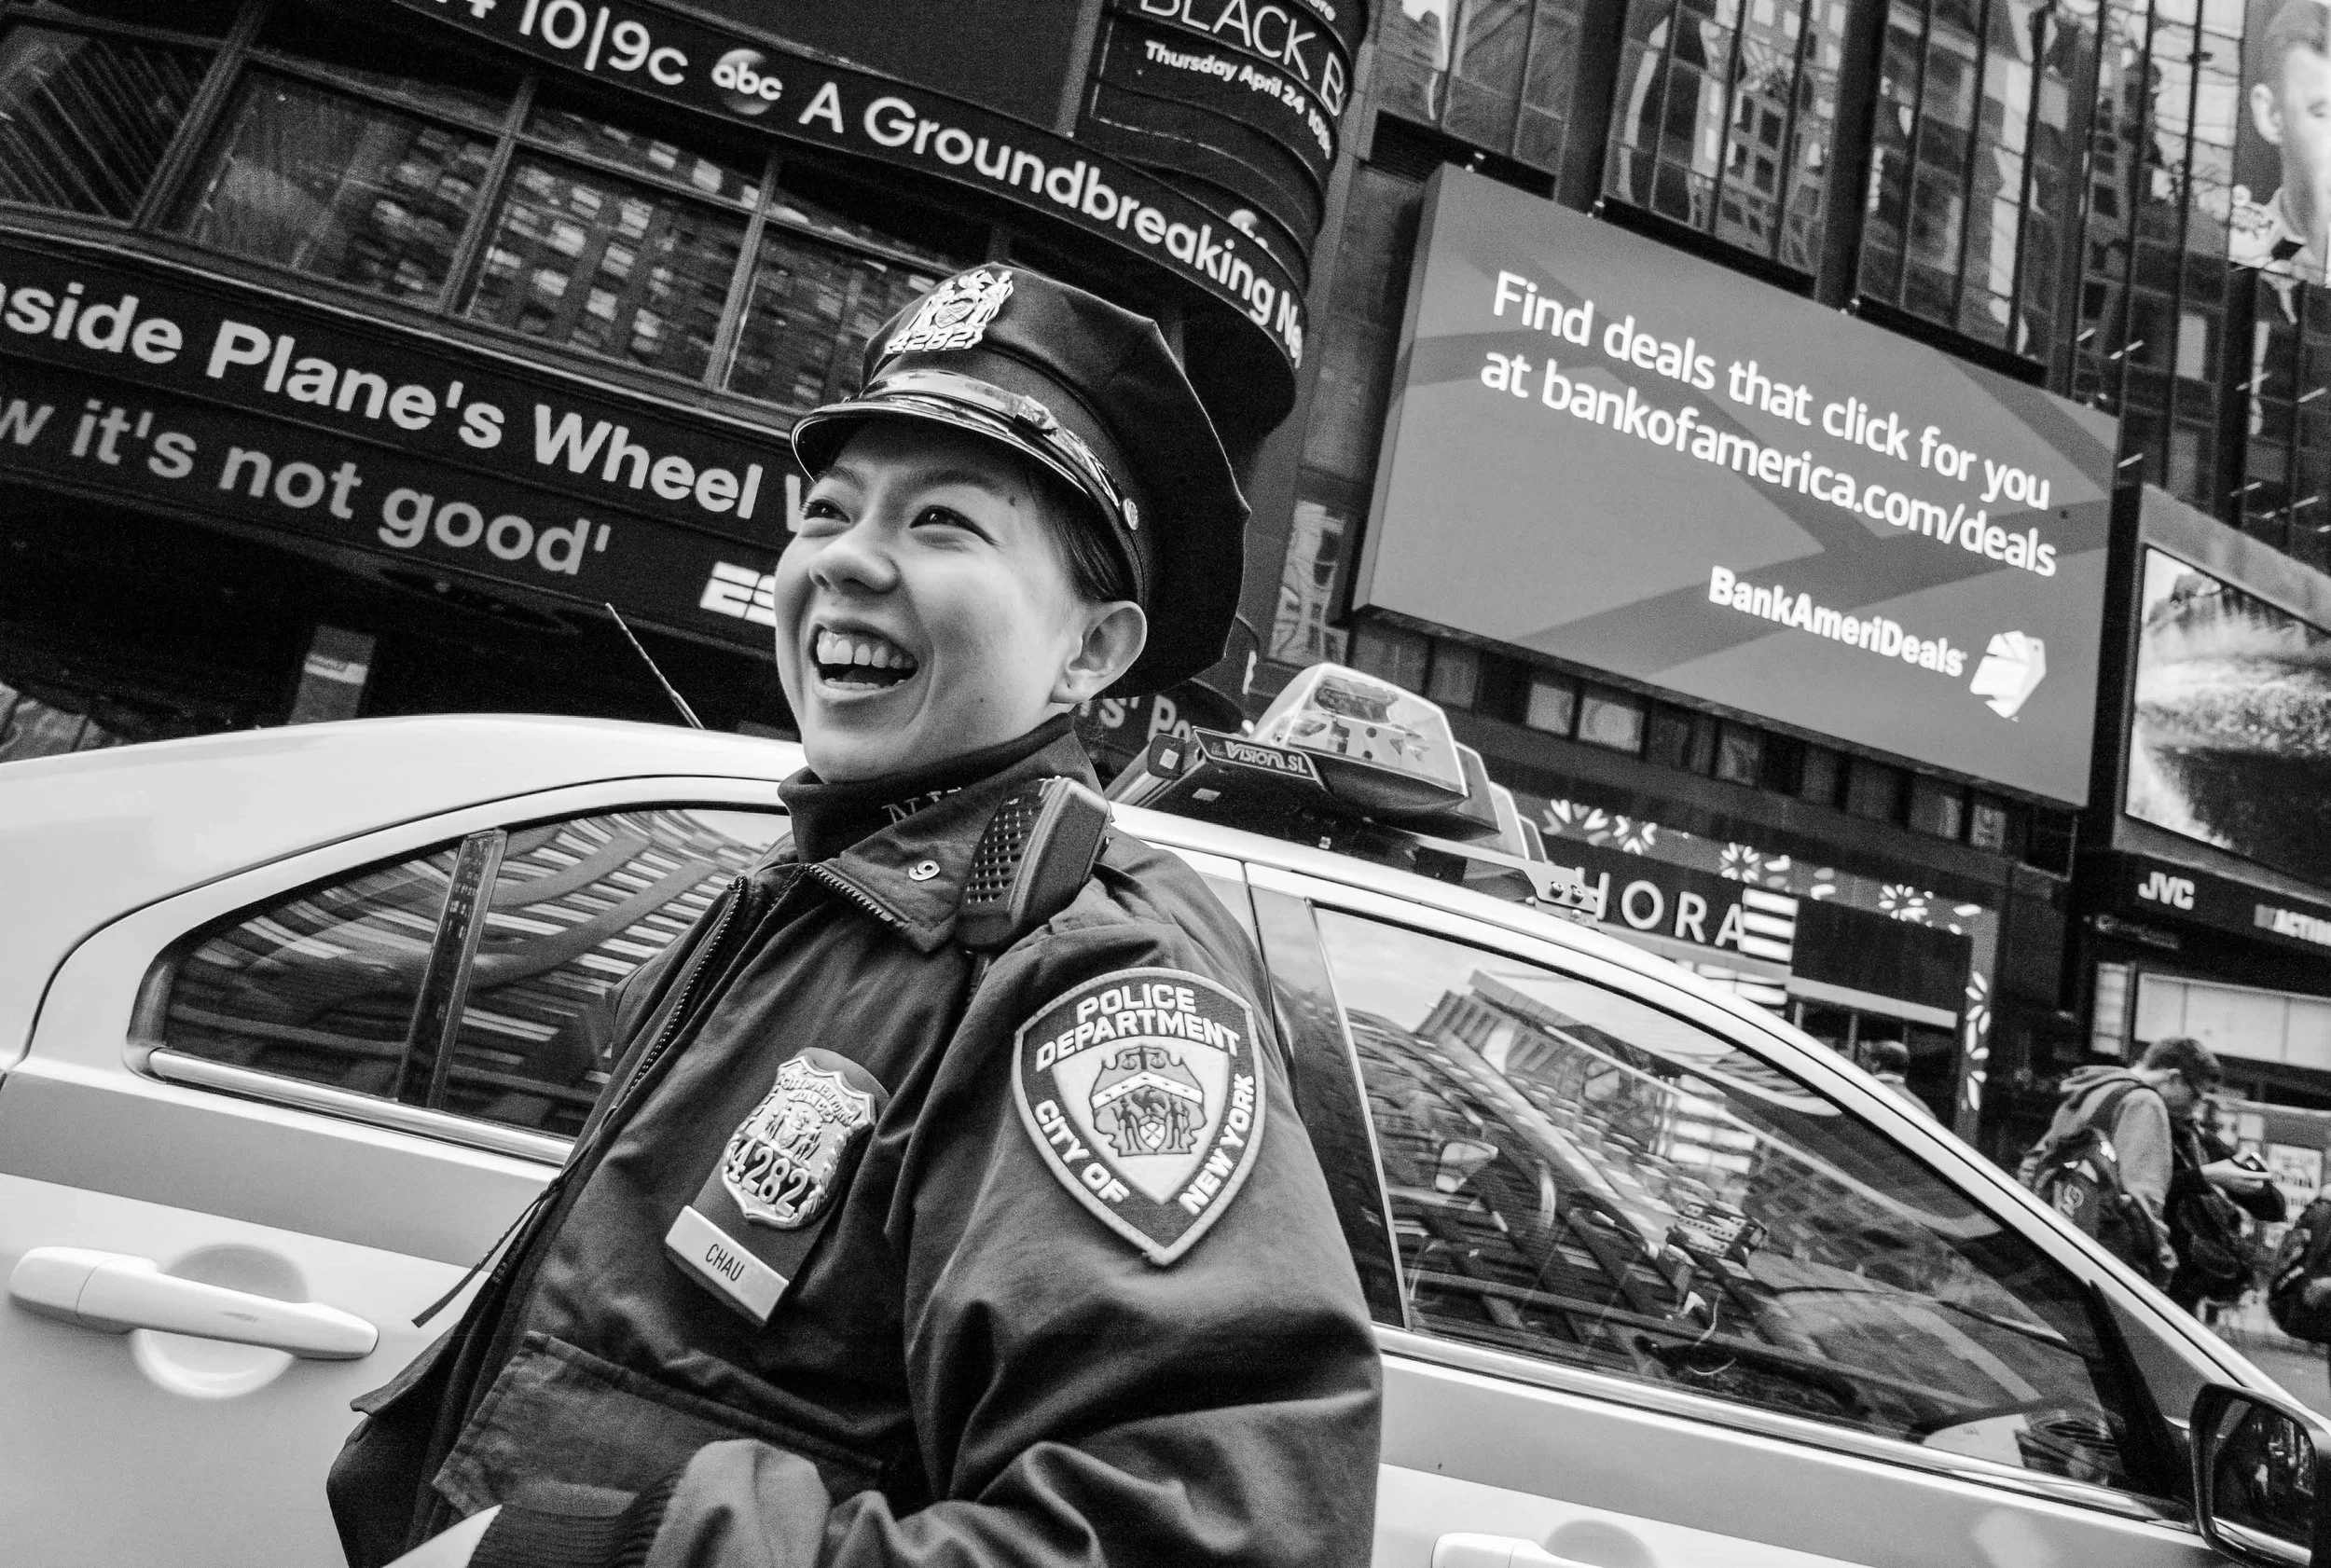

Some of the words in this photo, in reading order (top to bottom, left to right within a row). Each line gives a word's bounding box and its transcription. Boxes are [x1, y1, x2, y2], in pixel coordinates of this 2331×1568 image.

[1145, 39, 1238, 82] Thursday
[1238, 64, 1283, 98] April
[1282, 84, 1305, 116] 24
[711, 62, 783, 101] abc
[798, 82, 845, 133] A
[864, 97, 1276, 326] Groundbreaking
[0, 282, 183, 364] side
[206, 320, 505, 449] Plane's
[534, 403, 764, 520] Wheel
[1493, 270, 1594, 347] Find
[1603, 314, 1717, 391] deals
[1728, 360, 1814, 426] that
[1822, 396, 1910, 461] click
[1919, 425, 1978, 482] for
[1980, 459, 2050, 511] you
[71, 398, 197, 479] it's
[218, 447, 363, 519] not
[378, 488, 612, 576] good'
[1481, 351, 1532, 399] at
[1541, 358, 2057, 577] bankofamerica.com/deals
[1708, 565, 1967, 677] BankAmeriDeals
[2137, 871, 2196, 911] JVC
[1036, 1008, 1241, 1073] DEPARTMENT
[1076, 983, 1197, 1025] POLICE
[727, 1135, 813, 1218] 4282
[1034, 1098, 1090, 1163] CITY
[1081, 1162, 1131, 1204] OF
[1179, 1148, 1234, 1216] NEW
[1219, 1072, 1256, 1148] YORK
[705, 1243, 745, 1282] CHAU
